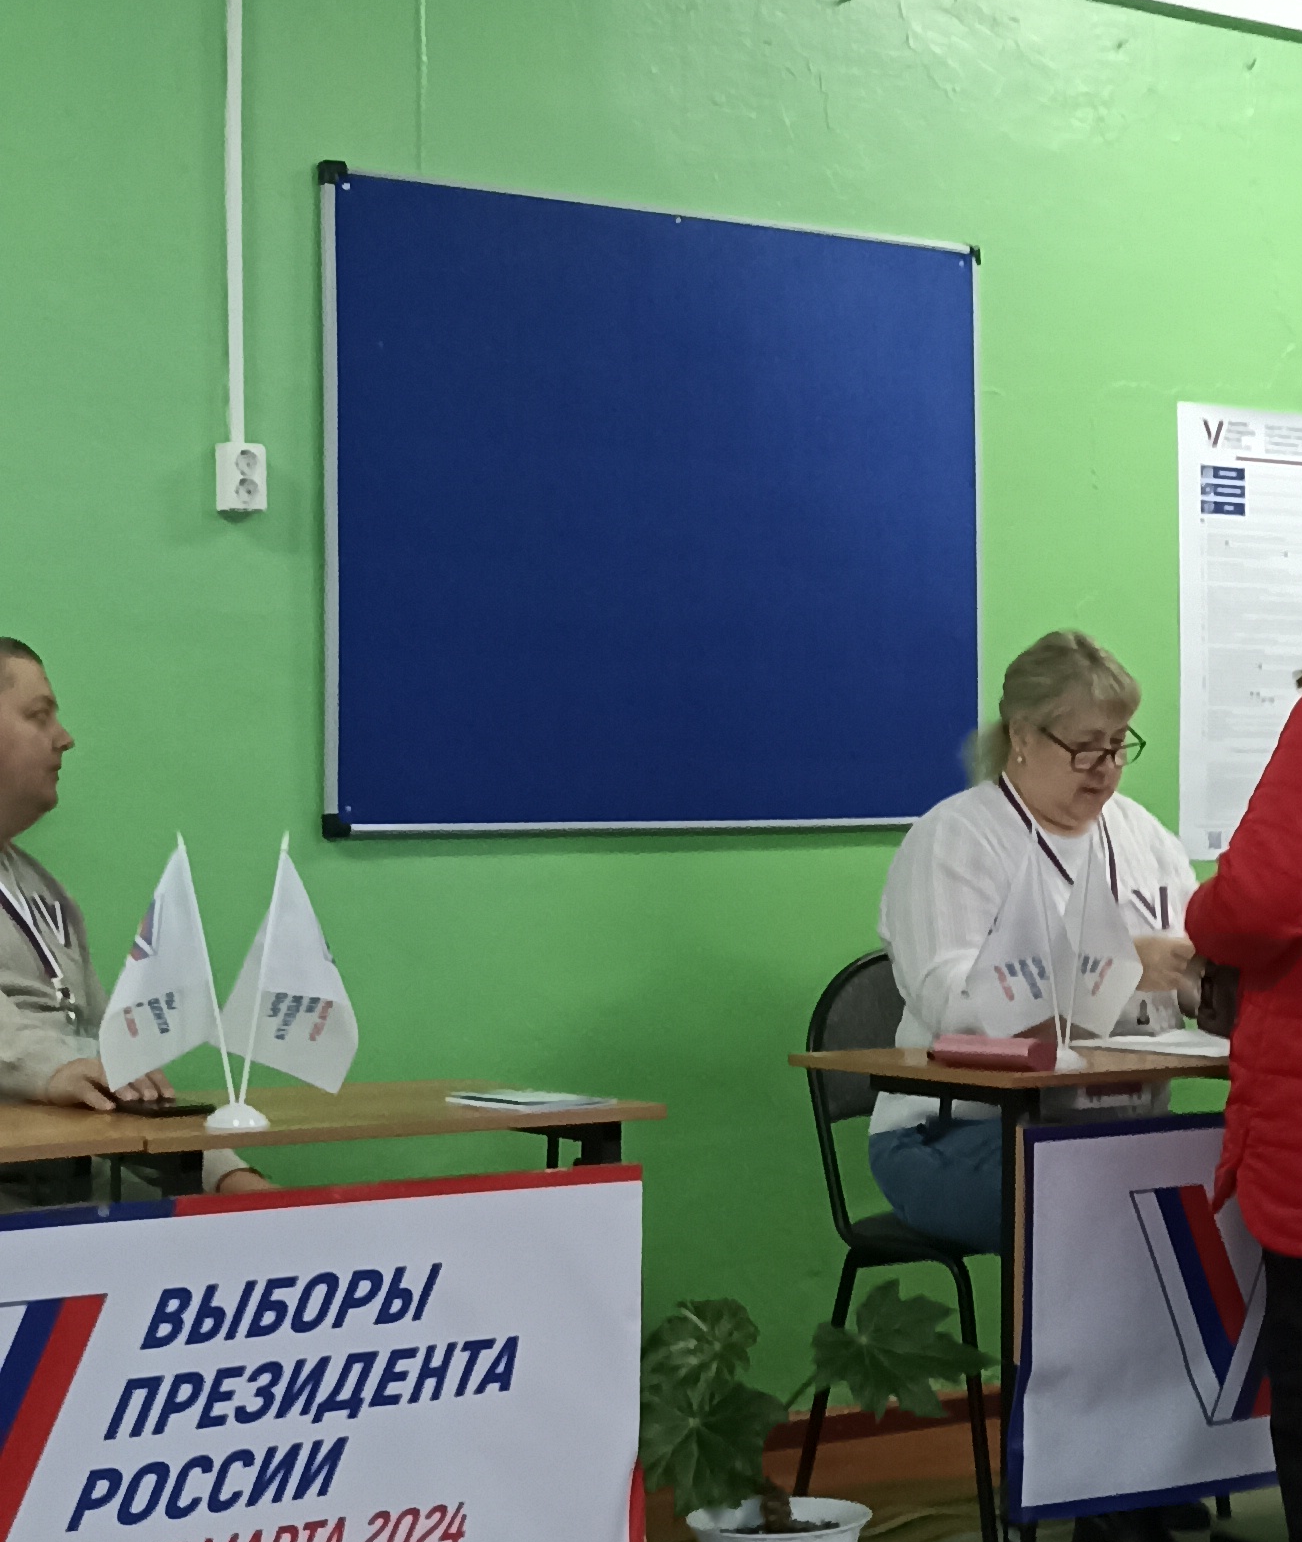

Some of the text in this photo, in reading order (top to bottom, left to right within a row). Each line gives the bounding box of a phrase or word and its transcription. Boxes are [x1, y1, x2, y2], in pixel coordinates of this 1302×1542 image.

[139, 1262, 443, 1351] ВЫБОРЫ
[103, 1335, 520, 1442] ПРЕЗИДЕНТА
[65, 1436, 350, 1533] РОССИИ
